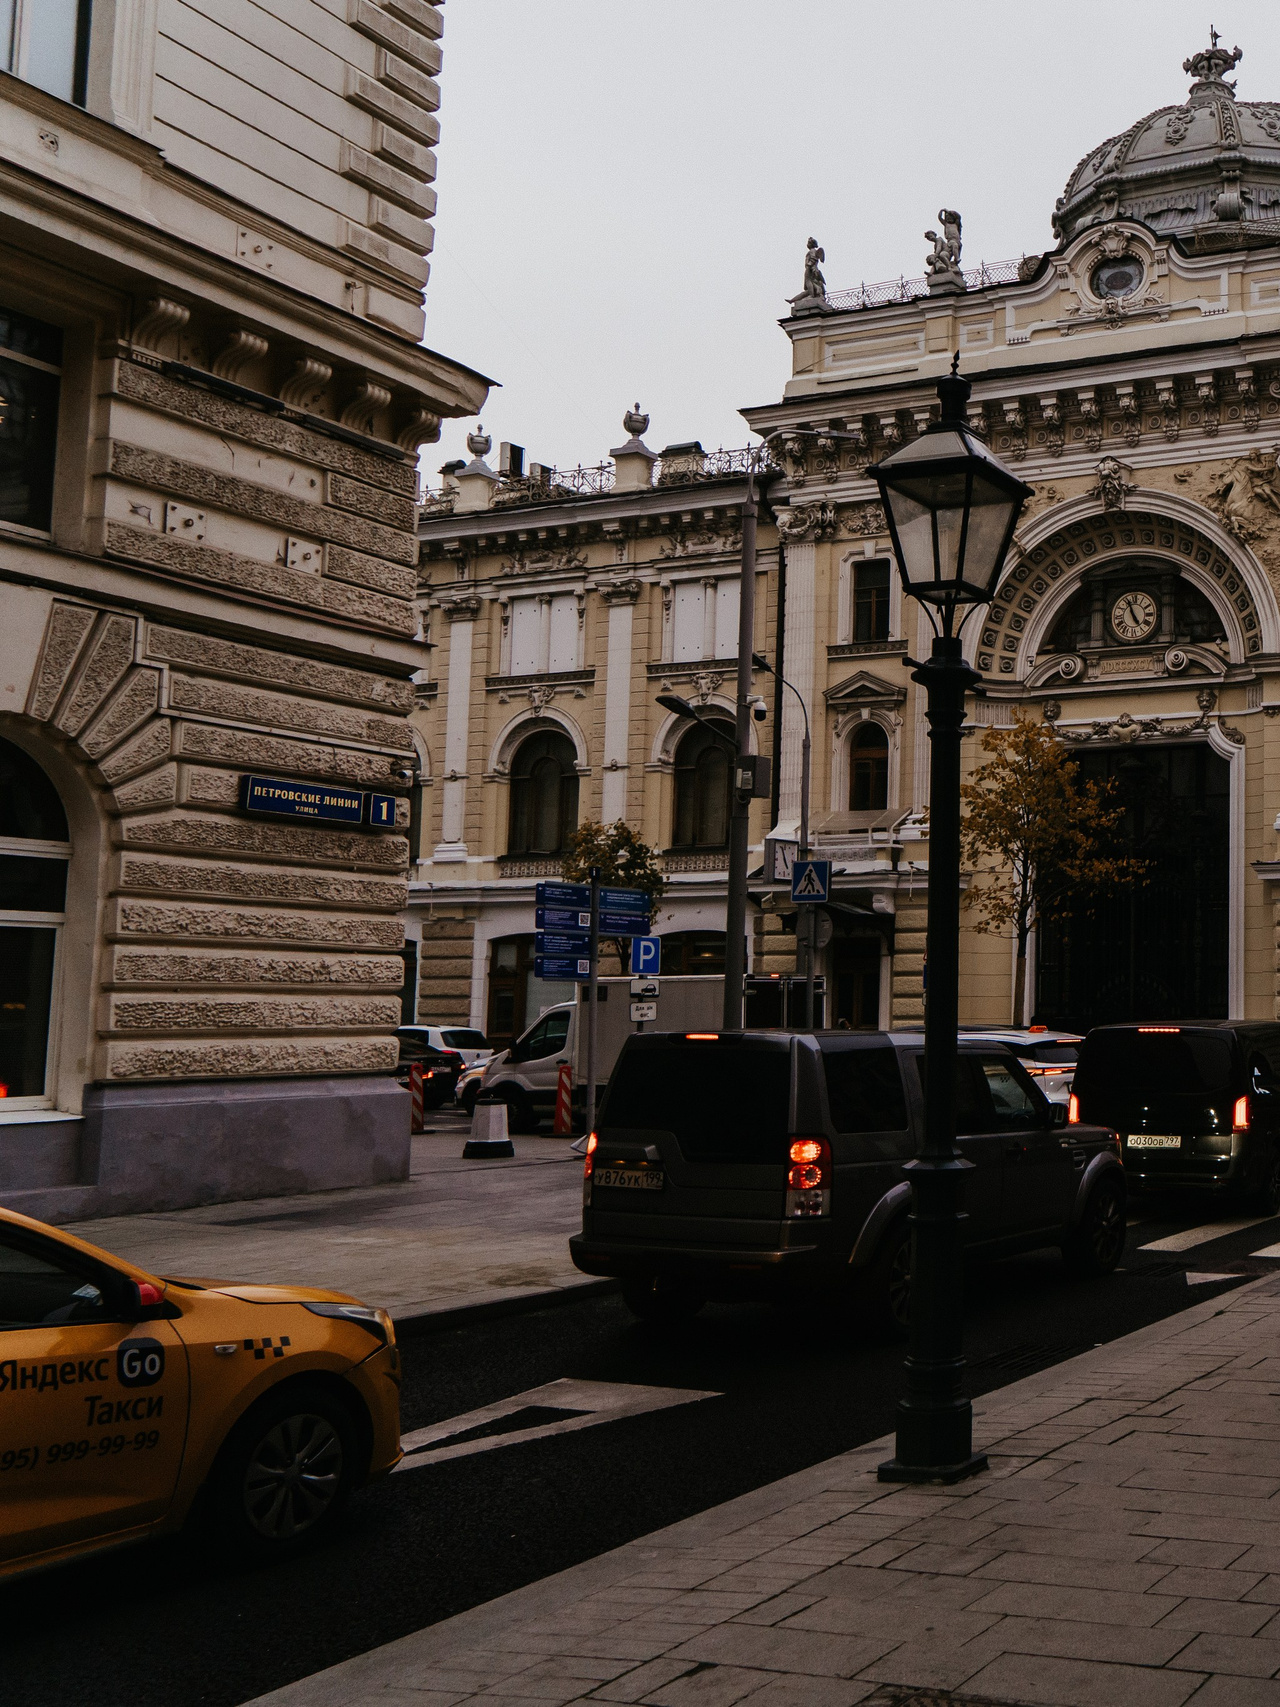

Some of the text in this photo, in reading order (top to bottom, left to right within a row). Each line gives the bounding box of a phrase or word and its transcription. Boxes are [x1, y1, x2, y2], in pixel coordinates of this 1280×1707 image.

[254, 786, 359, 809] ПЕТРОВСКИЕ ЛИНИИ
[295, 805, 319, 814] УЛИЦА
[379, 801, 388, 821] 1
[639, 940, 656, 970] P
[597, 1170, 661, 1187] У876УК 199
[0, 1348, 161, 1393] Яндекс Go
[85, 1395, 164, 1427] Такси
[47, 1430, 160, 1465] 999-99-99
